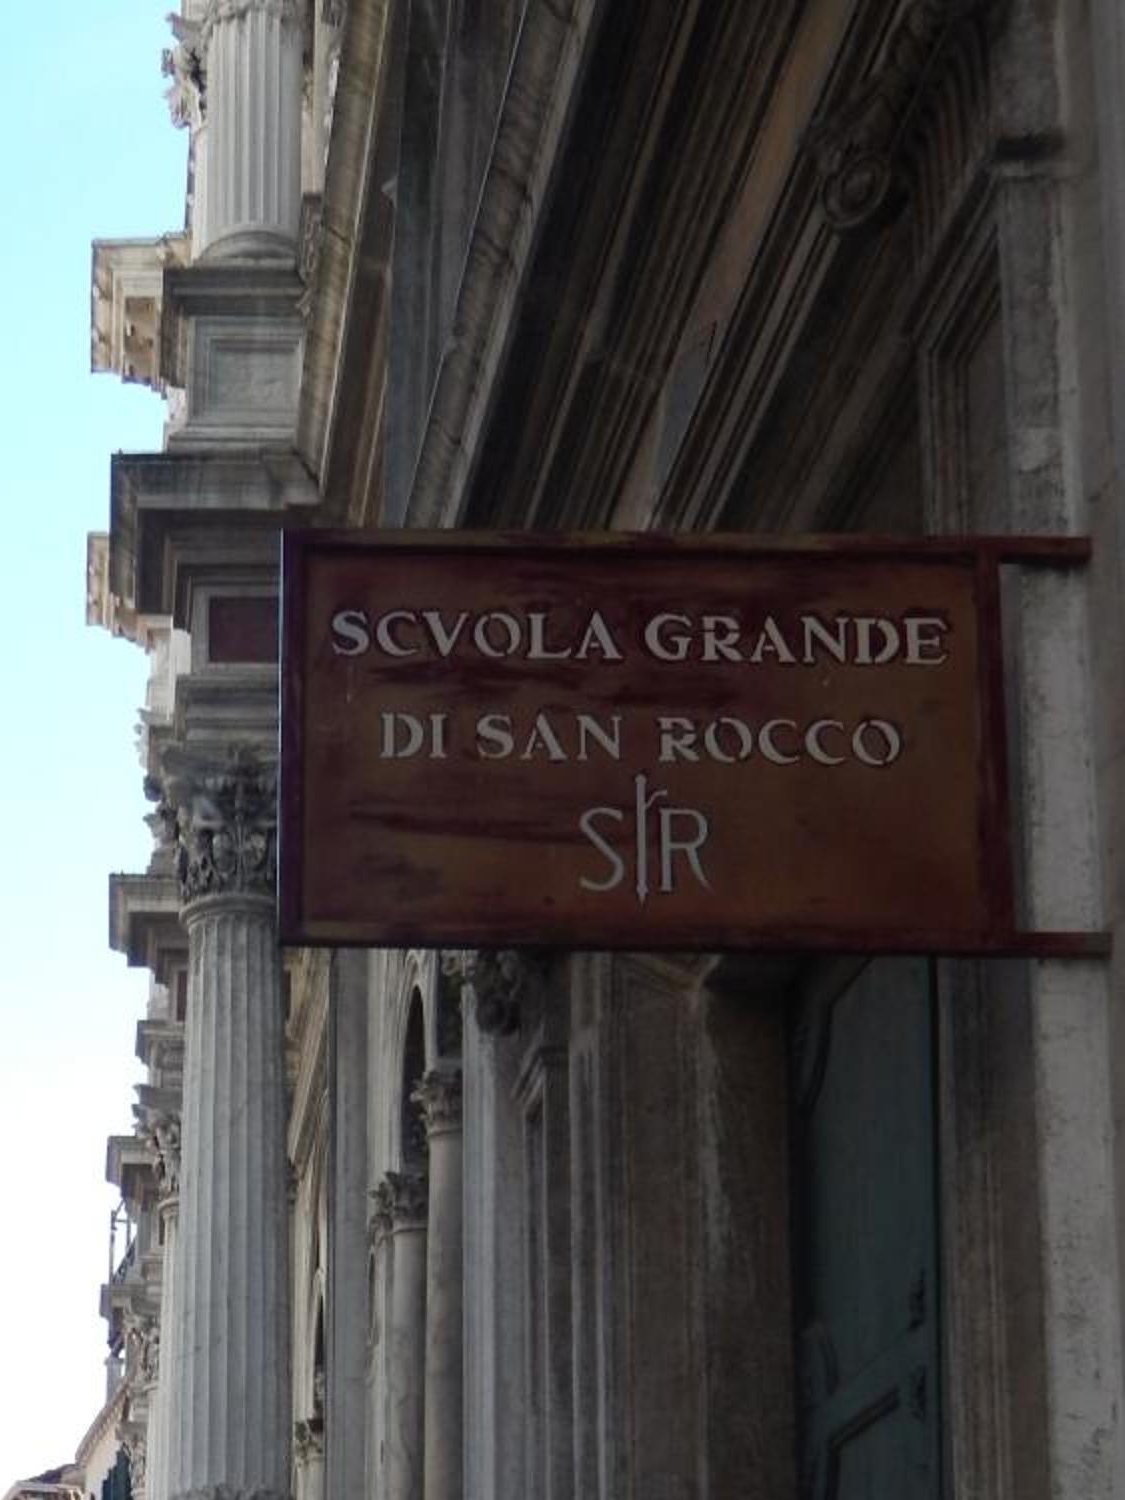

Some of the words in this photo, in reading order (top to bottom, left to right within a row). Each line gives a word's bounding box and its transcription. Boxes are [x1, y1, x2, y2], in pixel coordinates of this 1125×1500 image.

[332, 610, 622, 659] SCVOLA
[644, 612, 948, 665] GRANDE
[379, 713, 446, 759] DI
[476, 714, 621, 760] SAN
[658, 717, 901, 766] ROCCO
